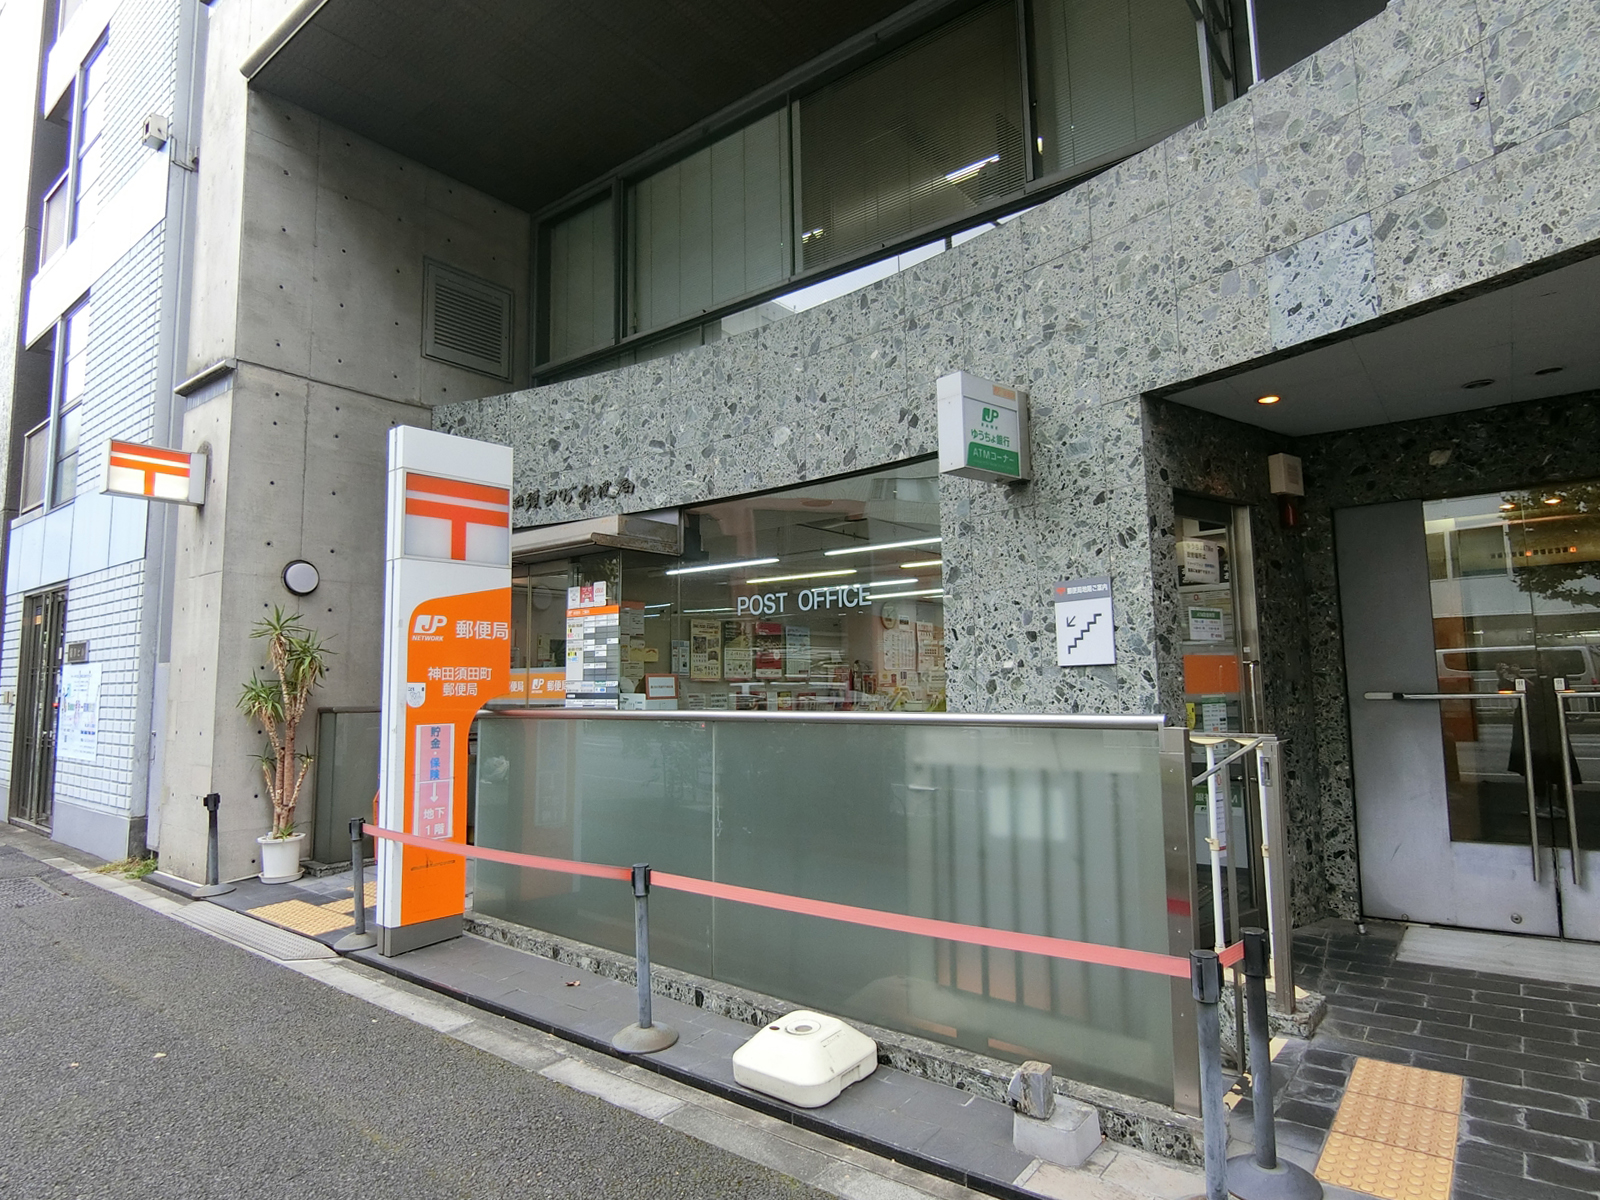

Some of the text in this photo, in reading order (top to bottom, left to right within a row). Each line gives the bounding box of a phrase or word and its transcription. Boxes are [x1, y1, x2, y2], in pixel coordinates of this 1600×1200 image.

[982, 407, 999, 423] JP
[971, 429, 1010, 447] ゆうちょ銀行
[973, 448, 1014, 463] ATMコーナー
[737, 585, 872, 616] POST OFFICE
[413, 614, 509, 641] JP 郵便局
[427, 666, 492, 681] 神田須田町
[442, 682, 478, 697] 郵便局
[429, 726, 441, 780] 貯金・保険
[423, 807, 446, 820] 地下
[425, 823, 445, 836] 1階
